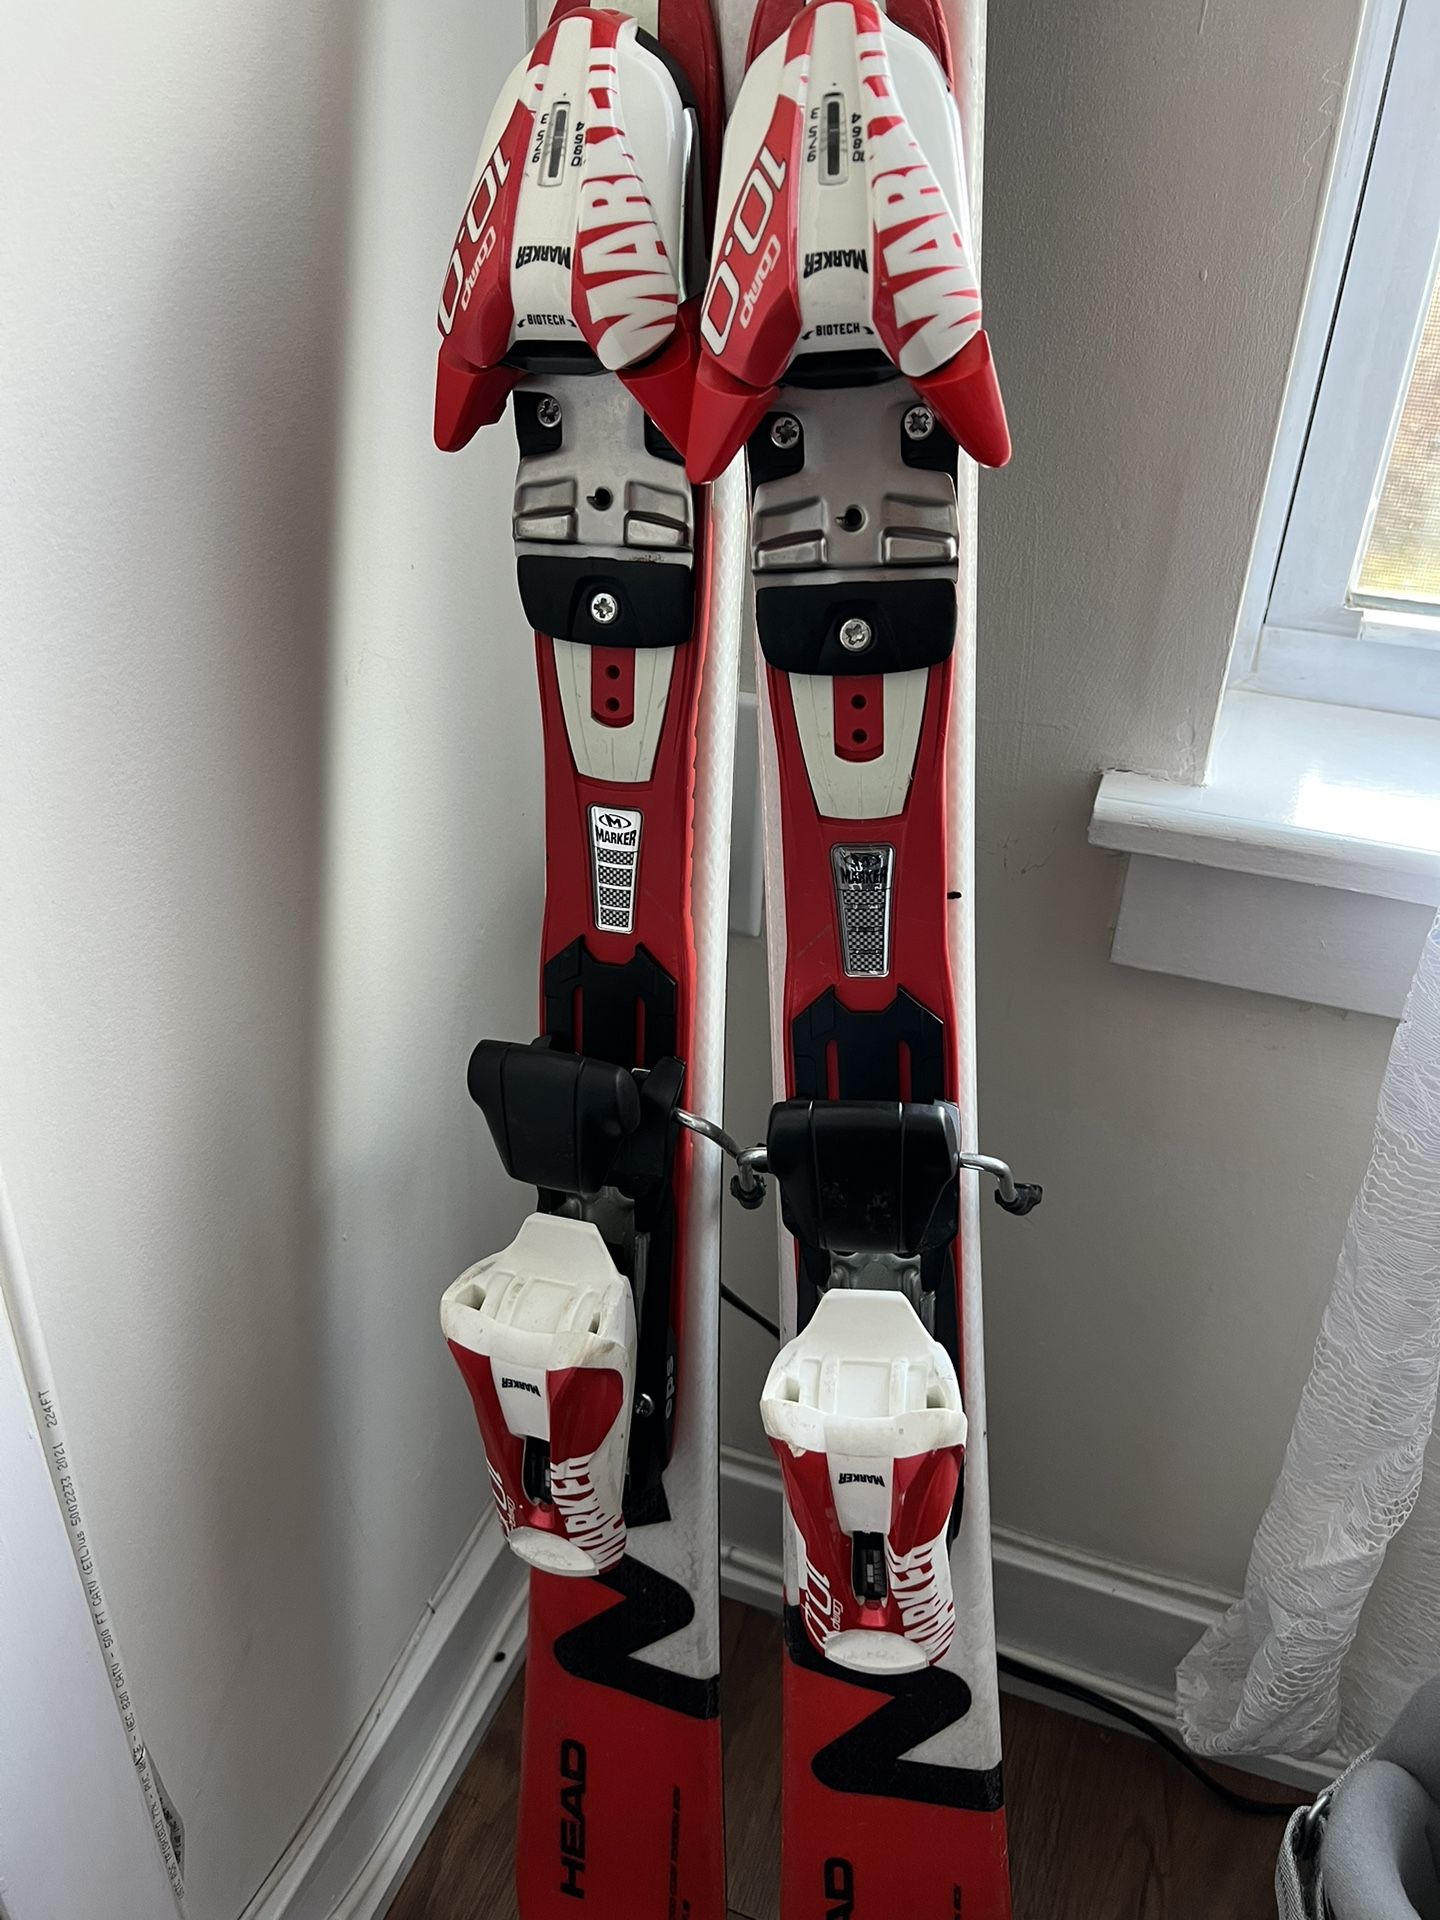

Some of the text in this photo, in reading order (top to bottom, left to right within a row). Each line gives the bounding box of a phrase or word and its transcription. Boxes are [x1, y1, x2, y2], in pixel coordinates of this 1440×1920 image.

[540, 113, 549, 124] 3
[810, 107, 820, 119] 3
[851, 112, 861, 123] 4
[536, 130, 545, 141] 5
[575, 121, 585, 131] 4
[808, 125, 818, 138] 5
[853, 138, 863, 149] 8
[438, 145, 511, 336] 10.0
[515, 246, 571, 270] MARKER
[700, 145, 788, 356] 10.0
[461, 226, 497, 312] Comp
[803, 249, 870, 278] MARKER
[740, 234, 782, 329] Comp
[527, 313, 567, 326] BIOTECH
[815, 322, 861, 337] BIOTECH
[595, 825, 637, 847] MARKER
[840, 864, 887, 885] MARKER
[502, 1377, 542, 1397] MARKER
[52, 1442, 68, 1471] 2021
[838, 1472, 885, 1487] MARKER
[60, 1475, 82, 1526] 5002233
[95, 1611, 107, 1625] FT
[101, 1629, 114, 1648] 500
[560, 1738, 587, 1900] HEAD
